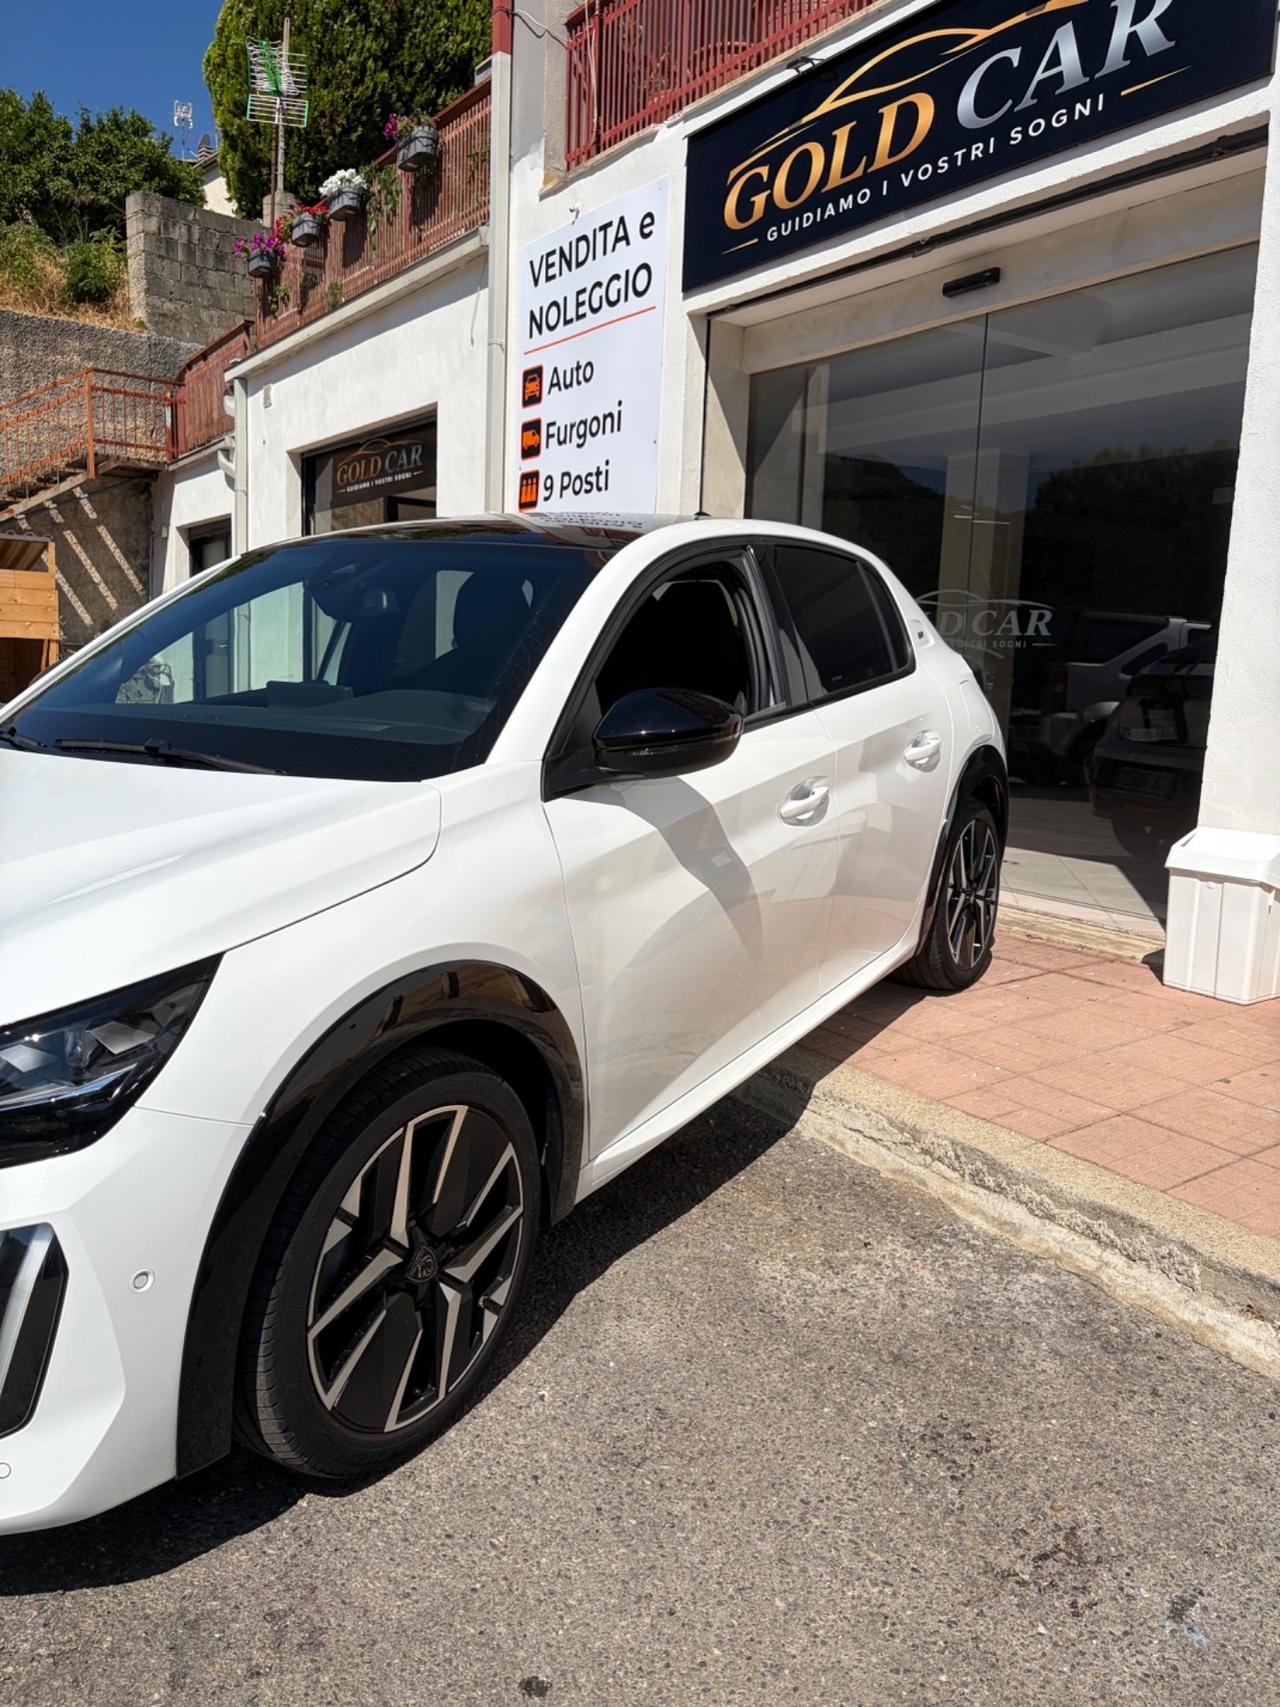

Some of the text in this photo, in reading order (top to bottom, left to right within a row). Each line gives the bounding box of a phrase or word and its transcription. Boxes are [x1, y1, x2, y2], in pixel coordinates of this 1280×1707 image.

[724, 0, 1176, 230] GOLD CAR
[766, 93, 1104, 242] GUIDIAMO I VOSTRI SOGNI
[529, 211, 655, 288] VENDITA e
[529, 262, 653, 339] NOLEGGIO
[547, 360, 594, 395] Auto
[545, 399, 623, 449] Furgoni
[337, 444, 423, 485] GOLD CAR
[543, 459, 610, 502] 9 Posti
[971, 610, 1052, 636] CAR
[992, 640, 1027, 649] SOGNI
